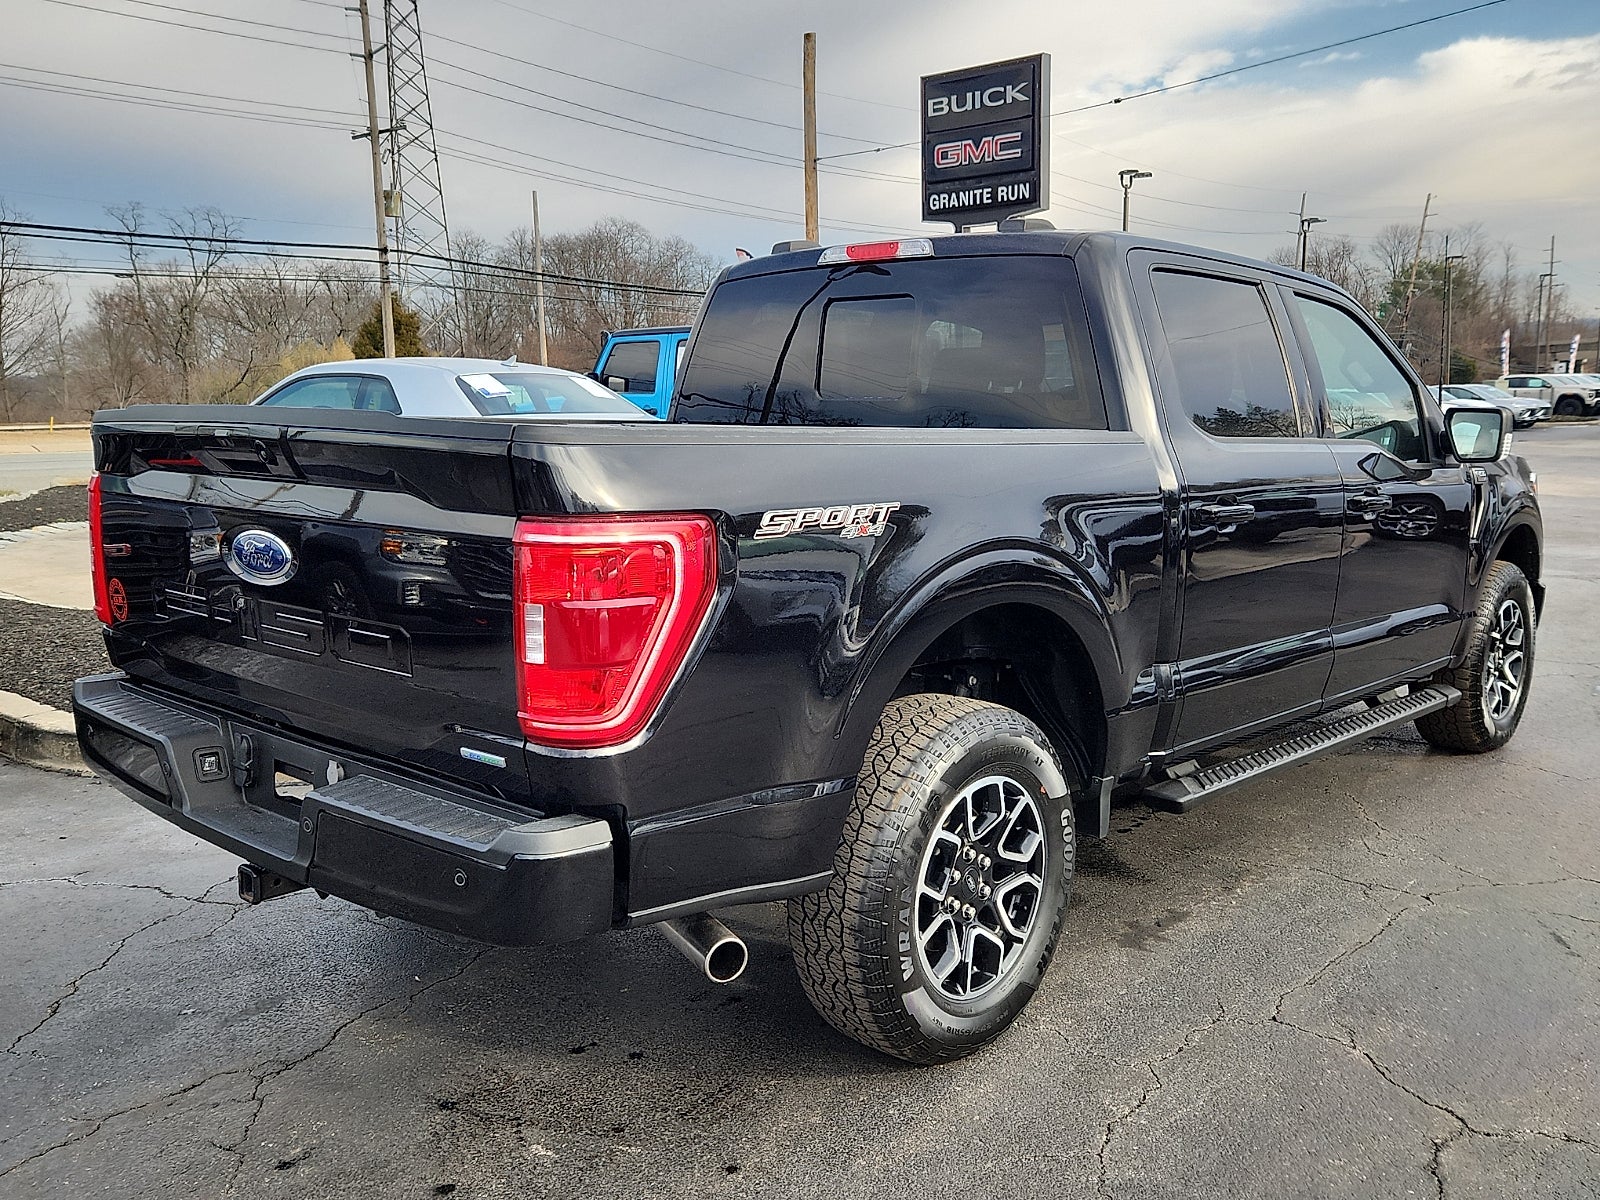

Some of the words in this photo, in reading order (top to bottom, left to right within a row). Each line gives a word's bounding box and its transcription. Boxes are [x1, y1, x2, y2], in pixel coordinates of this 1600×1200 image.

[928, 82, 1029, 117] BUICK
[934, 132, 1022, 168] GMC
[929, 188, 992, 210] GRANITE
[997, 183, 1030, 202] RUN
[753, 501, 901, 540] SPORT
[242, 539, 274, 569] Ford
[151, 581, 413, 677] F-150
[1035, 808, 1075, 977] GOODYEAR
